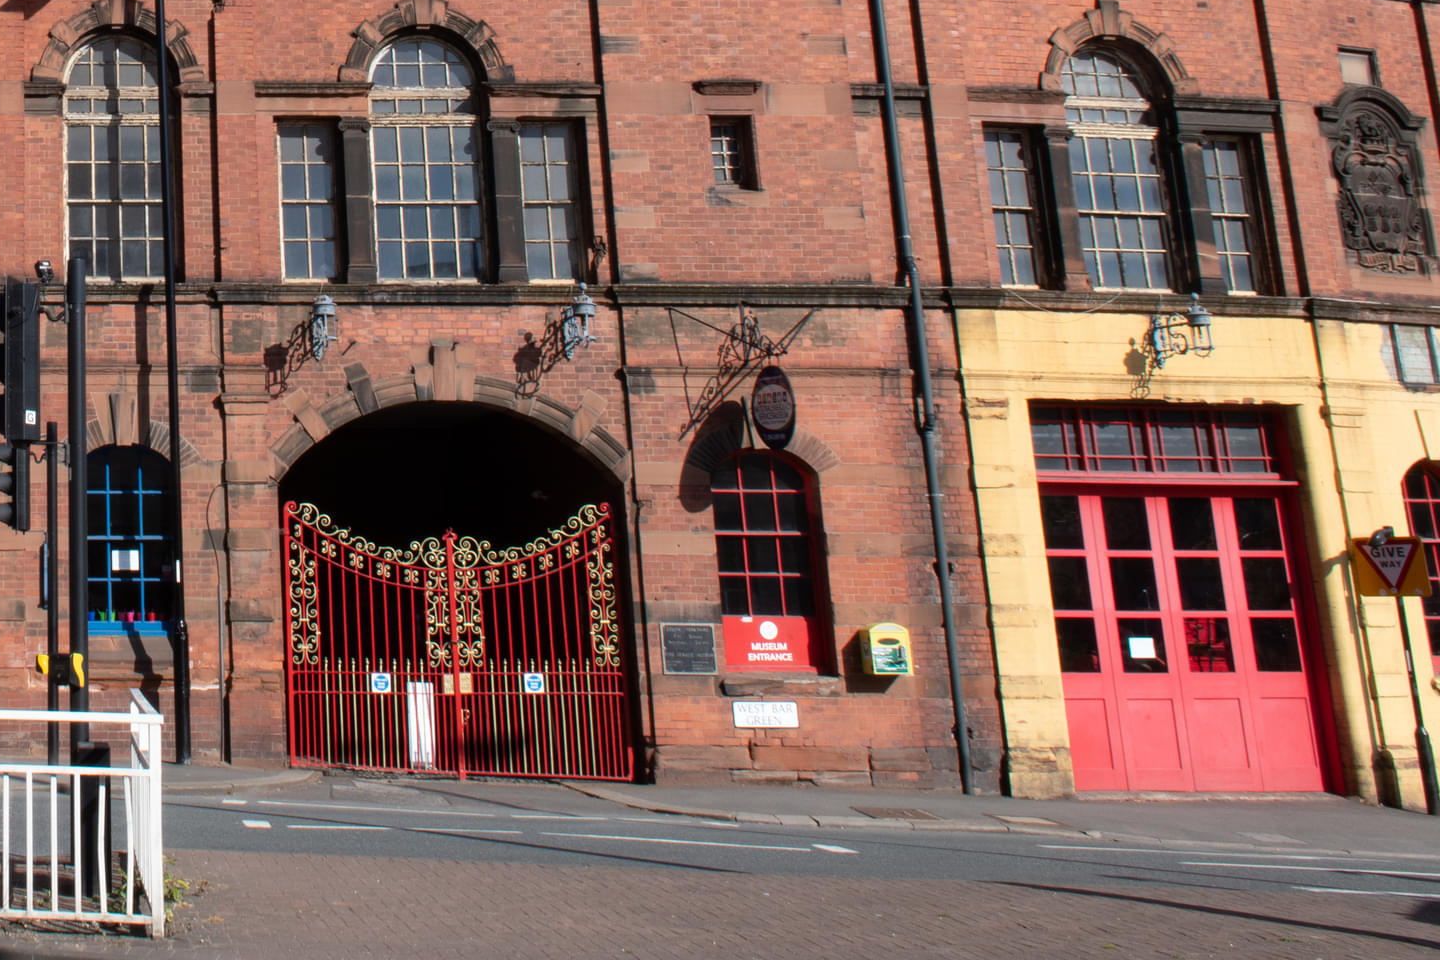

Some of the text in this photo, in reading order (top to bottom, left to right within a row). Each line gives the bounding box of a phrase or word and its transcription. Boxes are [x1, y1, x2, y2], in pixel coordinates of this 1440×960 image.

[1371, 546, 1405, 558] GIVE
[1380, 560, 1402, 568] WAY
[751, 642, 787, 650] MUSEUM
[748, 653, 793, 661] ENTRANCE
[737, 703, 793, 713] WEST BAR
[746, 715, 783, 725] GREEN
